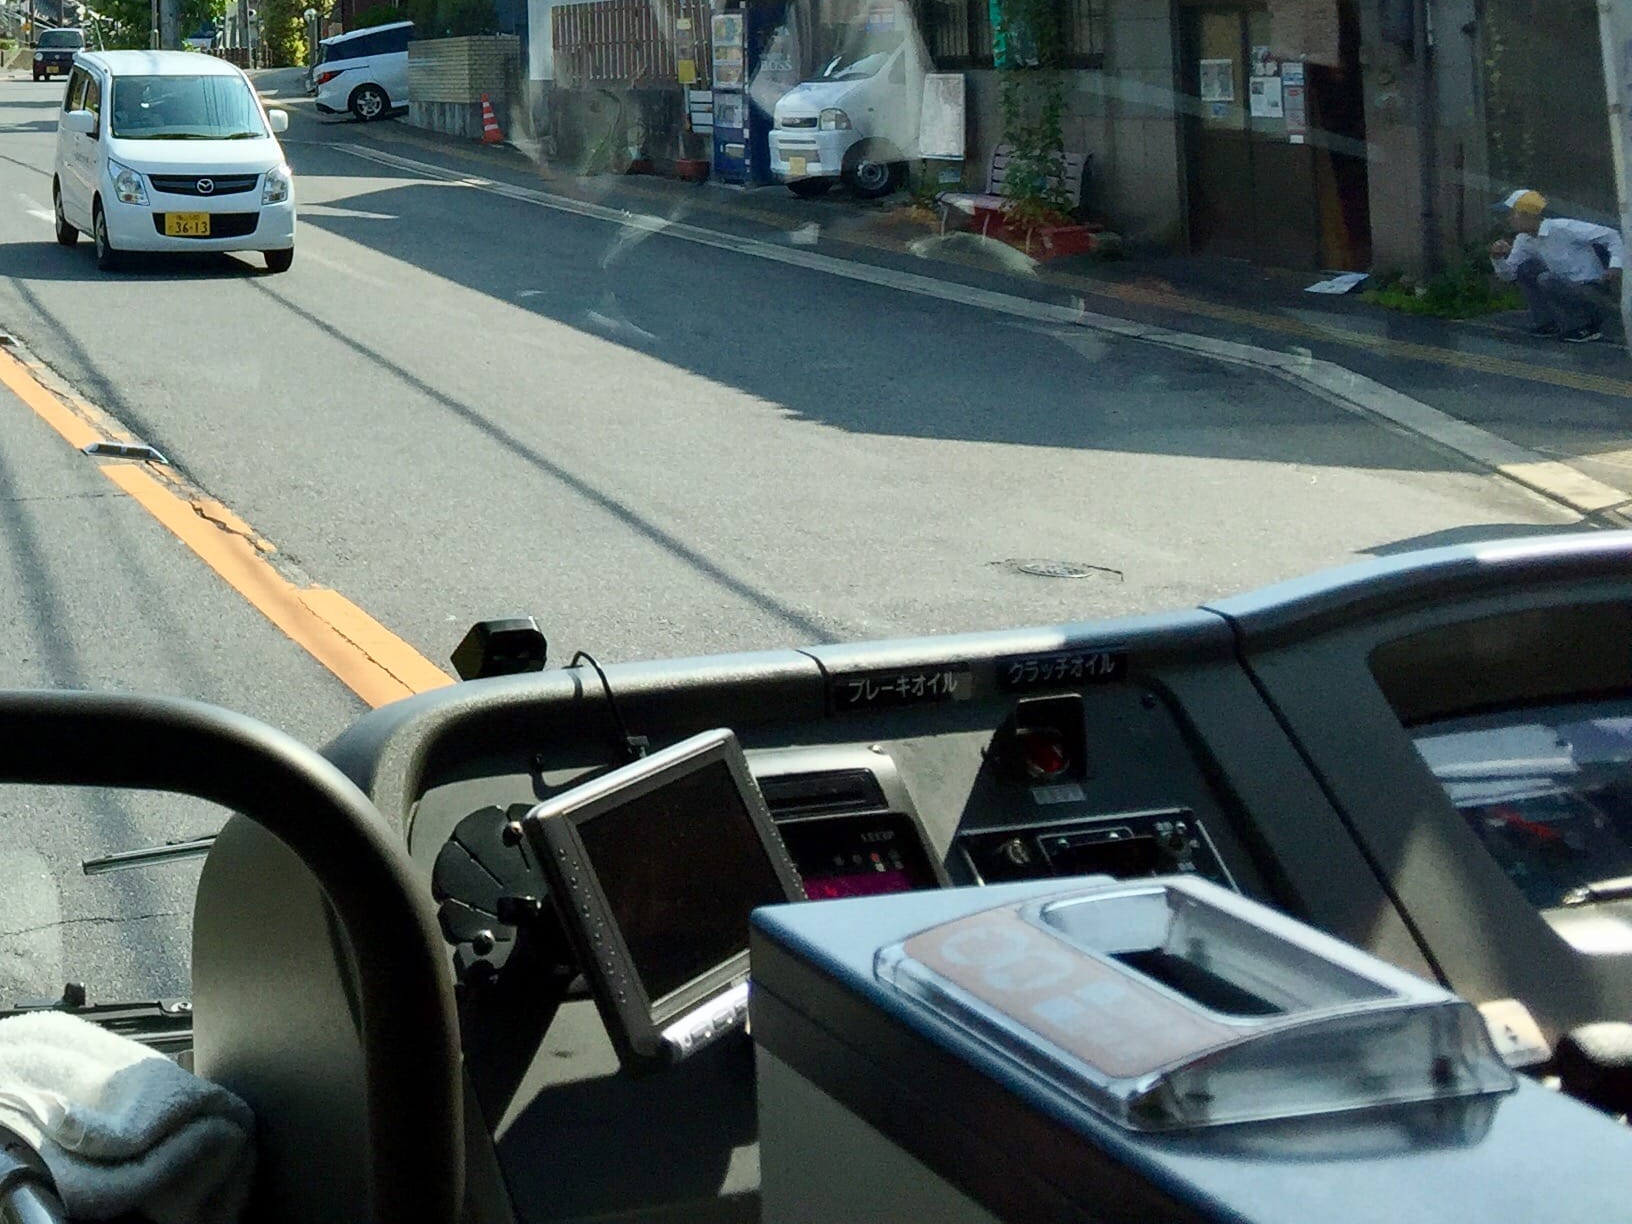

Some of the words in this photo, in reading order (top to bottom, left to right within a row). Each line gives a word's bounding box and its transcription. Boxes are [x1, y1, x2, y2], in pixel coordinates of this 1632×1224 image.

[1008, 654, 1116, 684] クラッチオイル
[848, 671, 958, 703] ブレーキオイル
